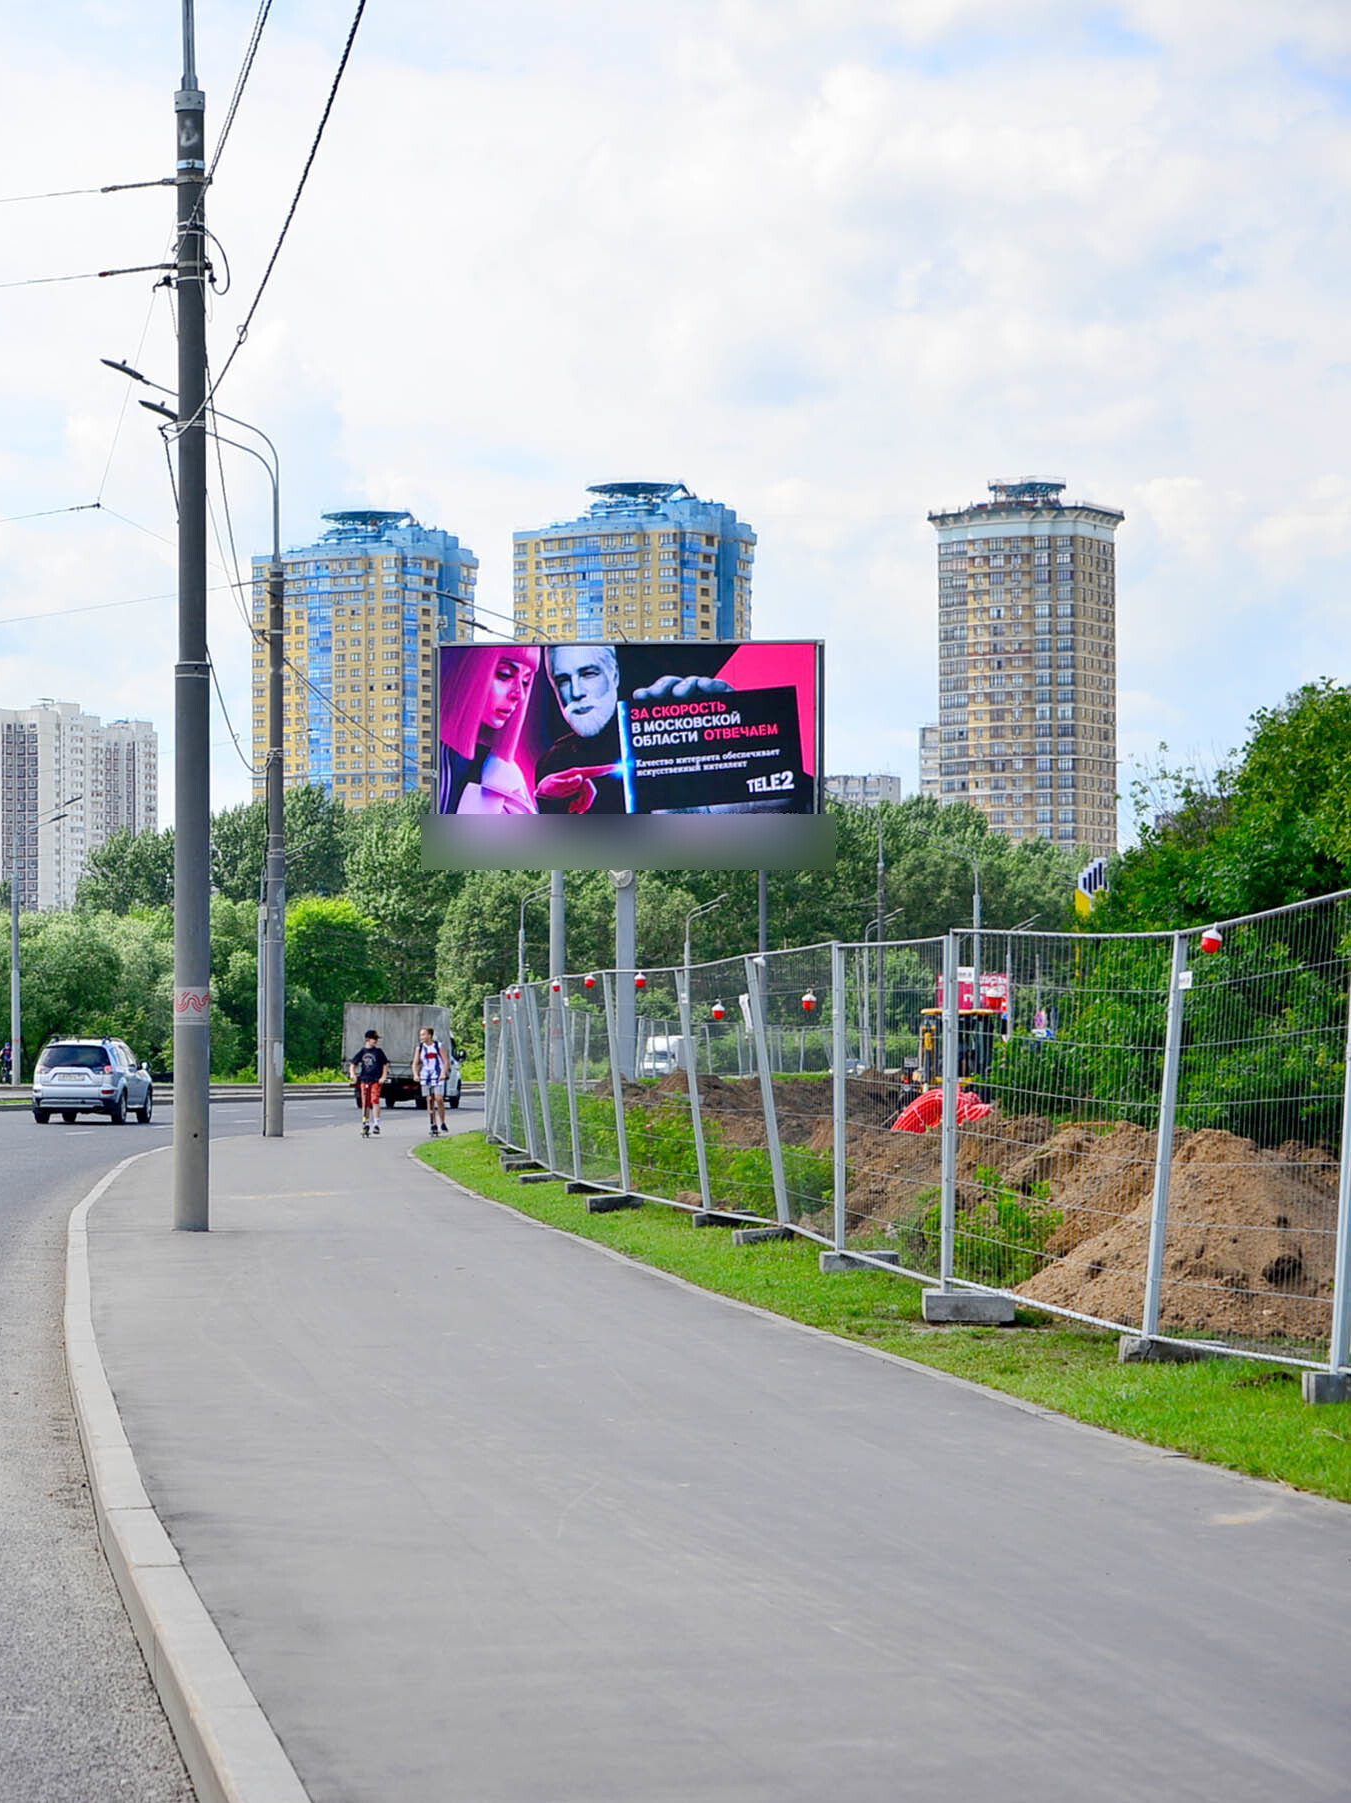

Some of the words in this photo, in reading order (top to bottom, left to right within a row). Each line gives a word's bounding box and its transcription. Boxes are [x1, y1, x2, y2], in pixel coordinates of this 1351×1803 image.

[630, 707, 650, 720] ЗА
[651, 701, 727, 718] СКОРОСТЬ
[631, 722, 641, 734] В
[644, 711, 741, 733] МОСКОВСКОЙ
[632, 731, 698, 747] ОБЛАСТИ
[704, 723, 778, 740] ОТВЕЧАЕМ
[636, 758, 674, 768] Качество
[676, 755, 720, 765] интернета
[722, 749, 781, 760] обеспечивает
[636, 764, 701, 777] искусственный
[703, 761, 748, 771] интеллект
[746, 771, 795, 793] TELE2
